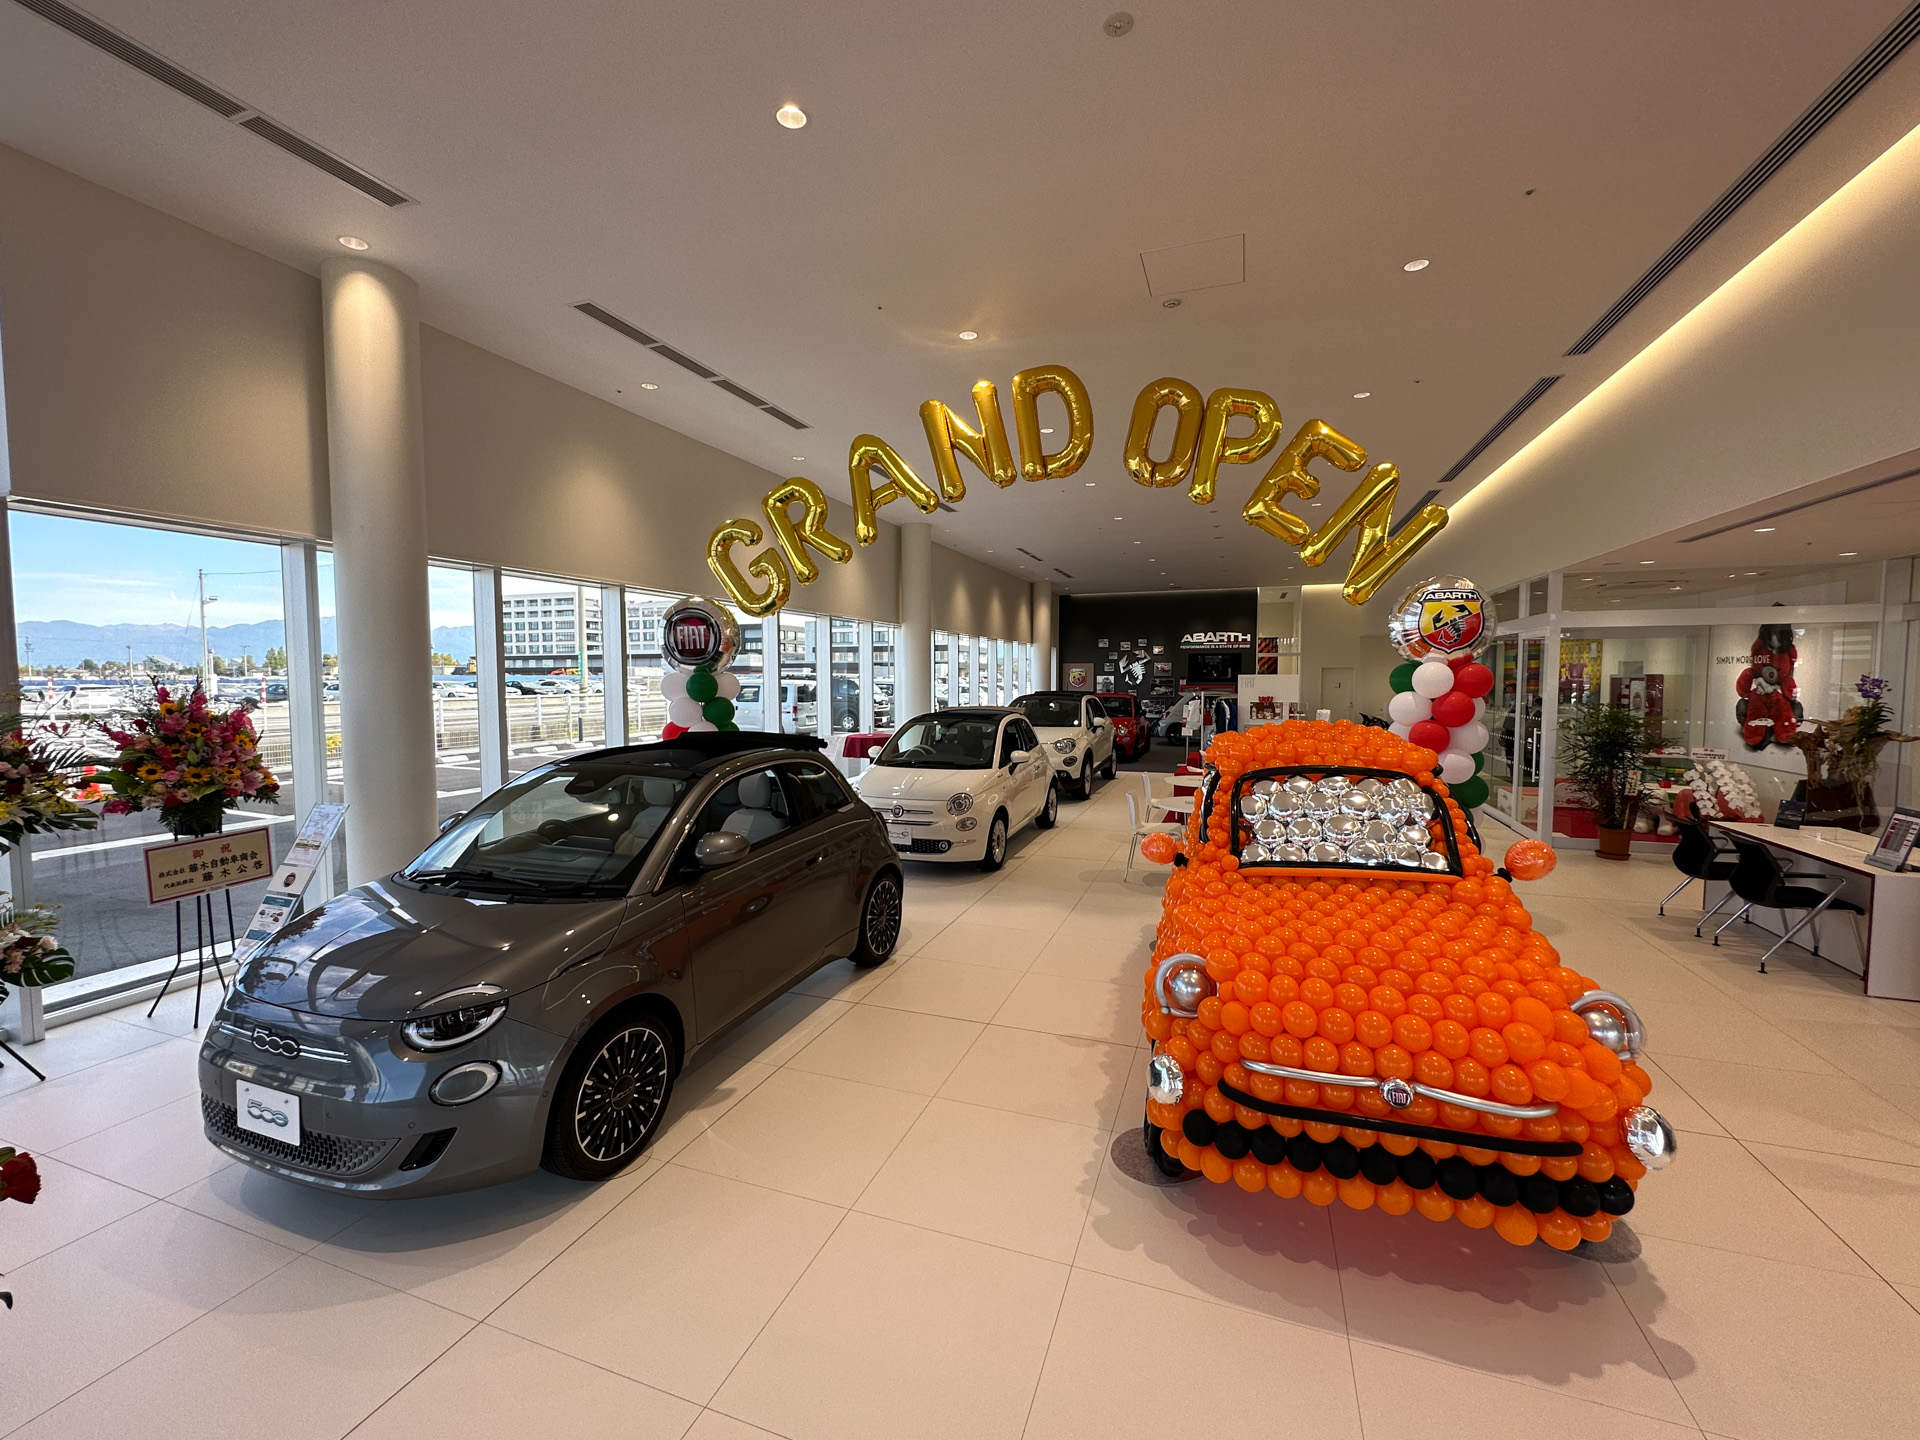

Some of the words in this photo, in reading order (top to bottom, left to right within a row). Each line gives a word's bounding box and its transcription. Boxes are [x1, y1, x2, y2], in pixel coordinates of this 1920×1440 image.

[706, 365, 1095, 617] GRAND
[1123, 377, 1449, 606] OPEN
[676, 625, 706, 650] FIAT
[1180, 631, 1251, 642] ABARTH
[1716, 656, 1735, 664] SIMPLY
[1735, 655, 1753, 664] MORE
[1753, 654, 1770, 664] LOVE
[1240, 677, 1256, 688] FIAT
[252, 1027, 298, 1057] 500
[1391, 1091, 1408, 1104] FIAT
